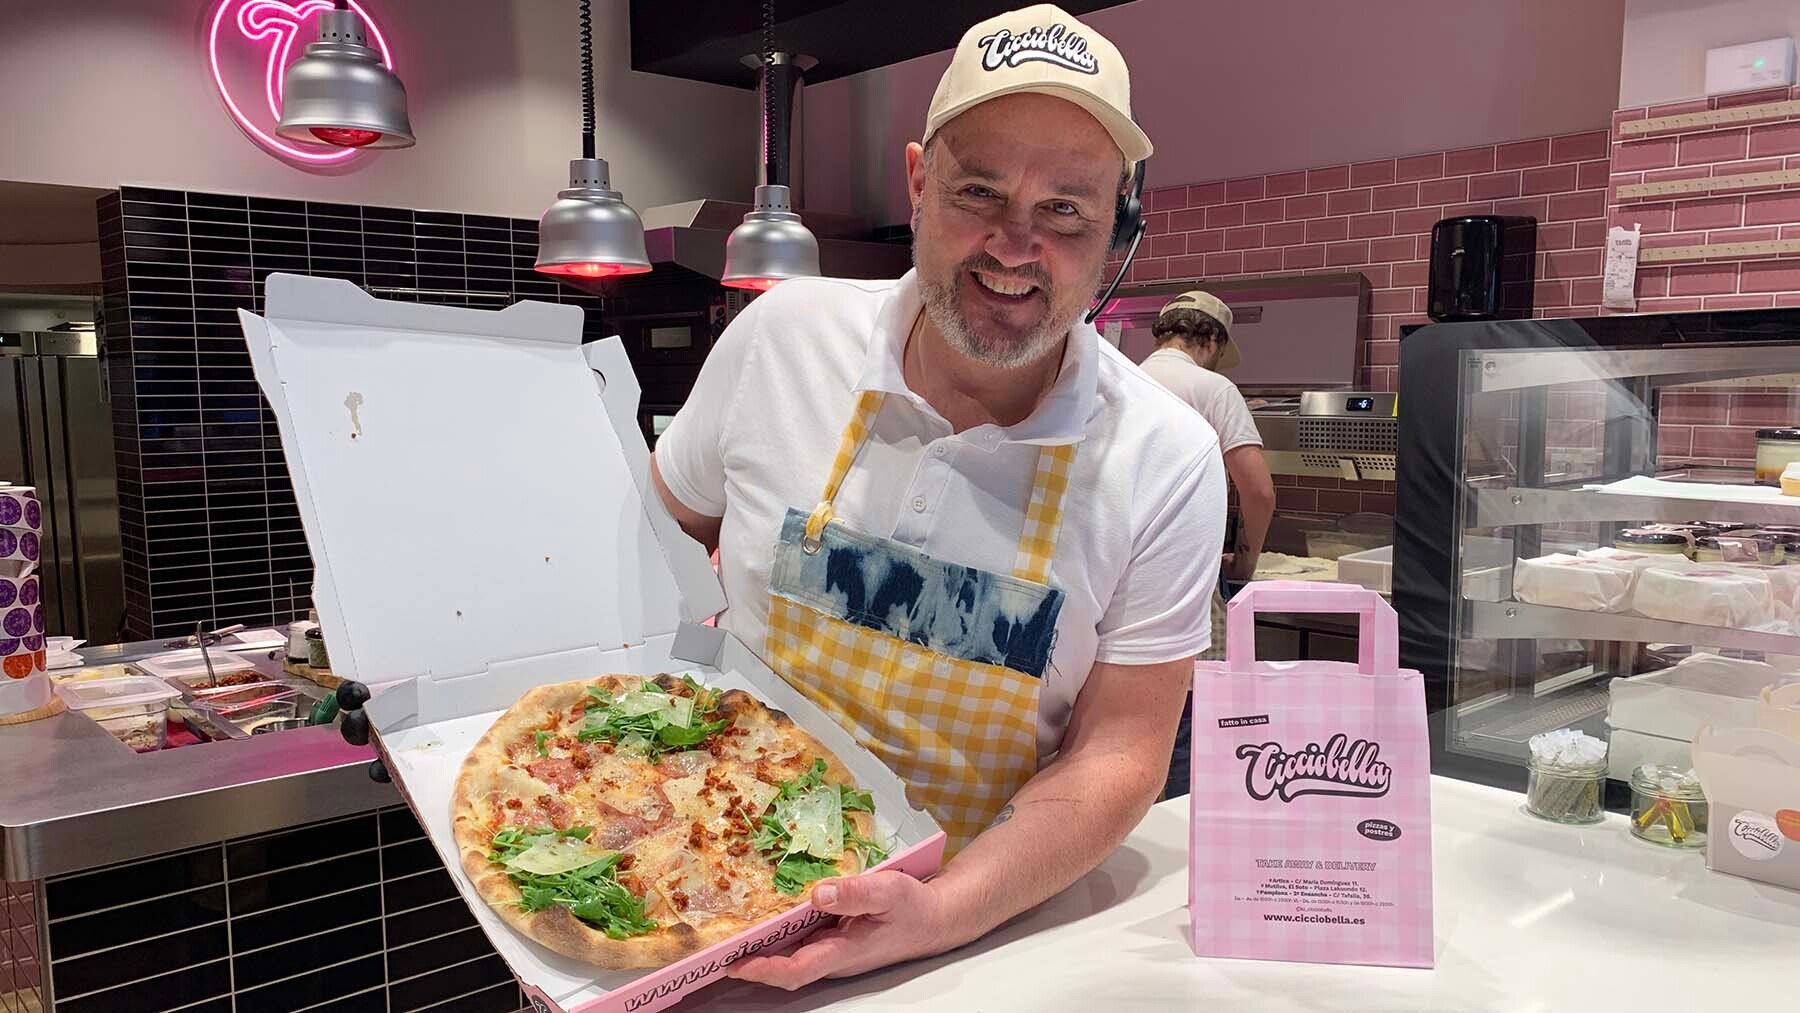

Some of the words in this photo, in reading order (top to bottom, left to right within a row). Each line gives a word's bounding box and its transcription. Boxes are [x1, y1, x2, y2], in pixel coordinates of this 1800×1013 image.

[978, 23, 1099, 75] Cicciobella
[1220, 719, 1240, 727] fatto
[1236, 733, 1392, 802] Cicciobella
[1365, 821, 1388, 830] pizzas
[1364, 828, 1393, 837] postres
[1255, 859, 1283, 868] TAKE
[1284, 860, 1314, 869] AWAY
[1315, 860, 1323, 870] &
[1324, 860, 1377, 871] DELIVERY
[1263, 914, 1365, 925] www.cicciobella.es
